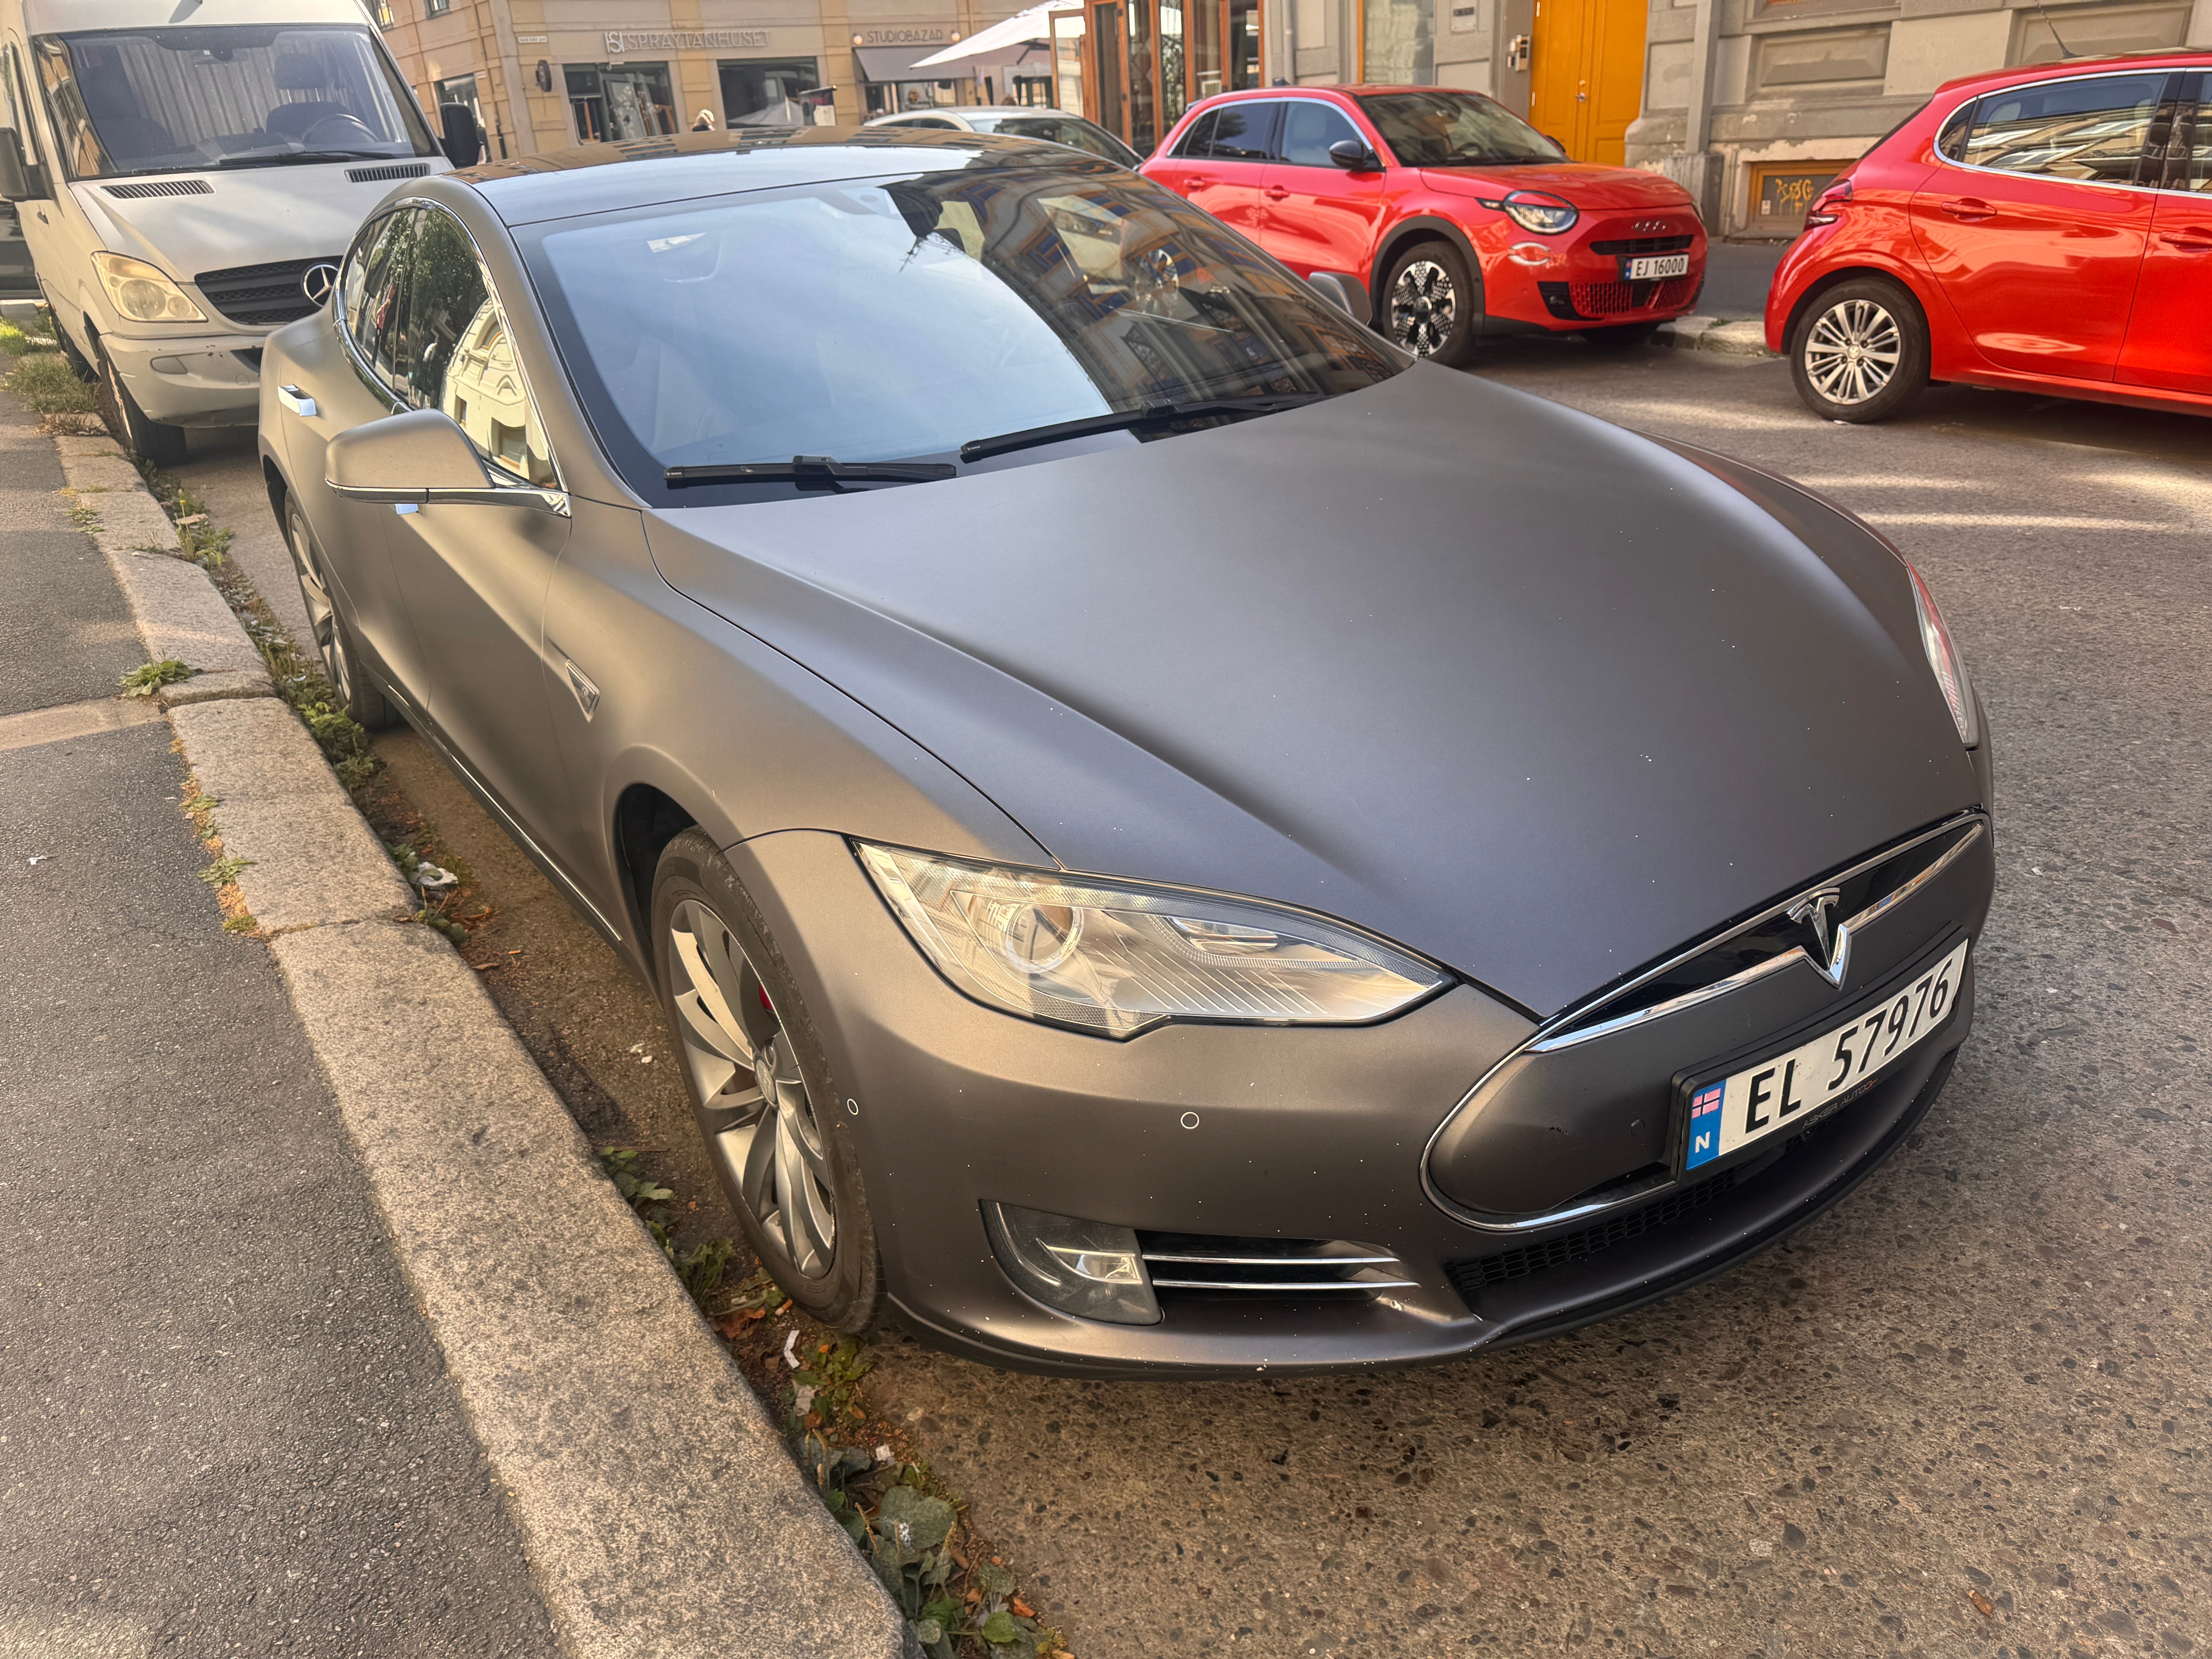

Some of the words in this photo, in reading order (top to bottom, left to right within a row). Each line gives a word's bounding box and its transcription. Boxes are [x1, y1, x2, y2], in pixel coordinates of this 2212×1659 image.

[627, 30, 769, 49] SPRAYTANHUSET
[867, 29, 943, 43] STUDIOBAZAR
[1636, 260, 1649, 276] EJ
[1654, 258, 1684, 275] 16000
[1745, 1057, 1801, 1133] EL
[1827, 957, 1952, 1091] 57976
[1695, 1132, 1710, 1153] N
